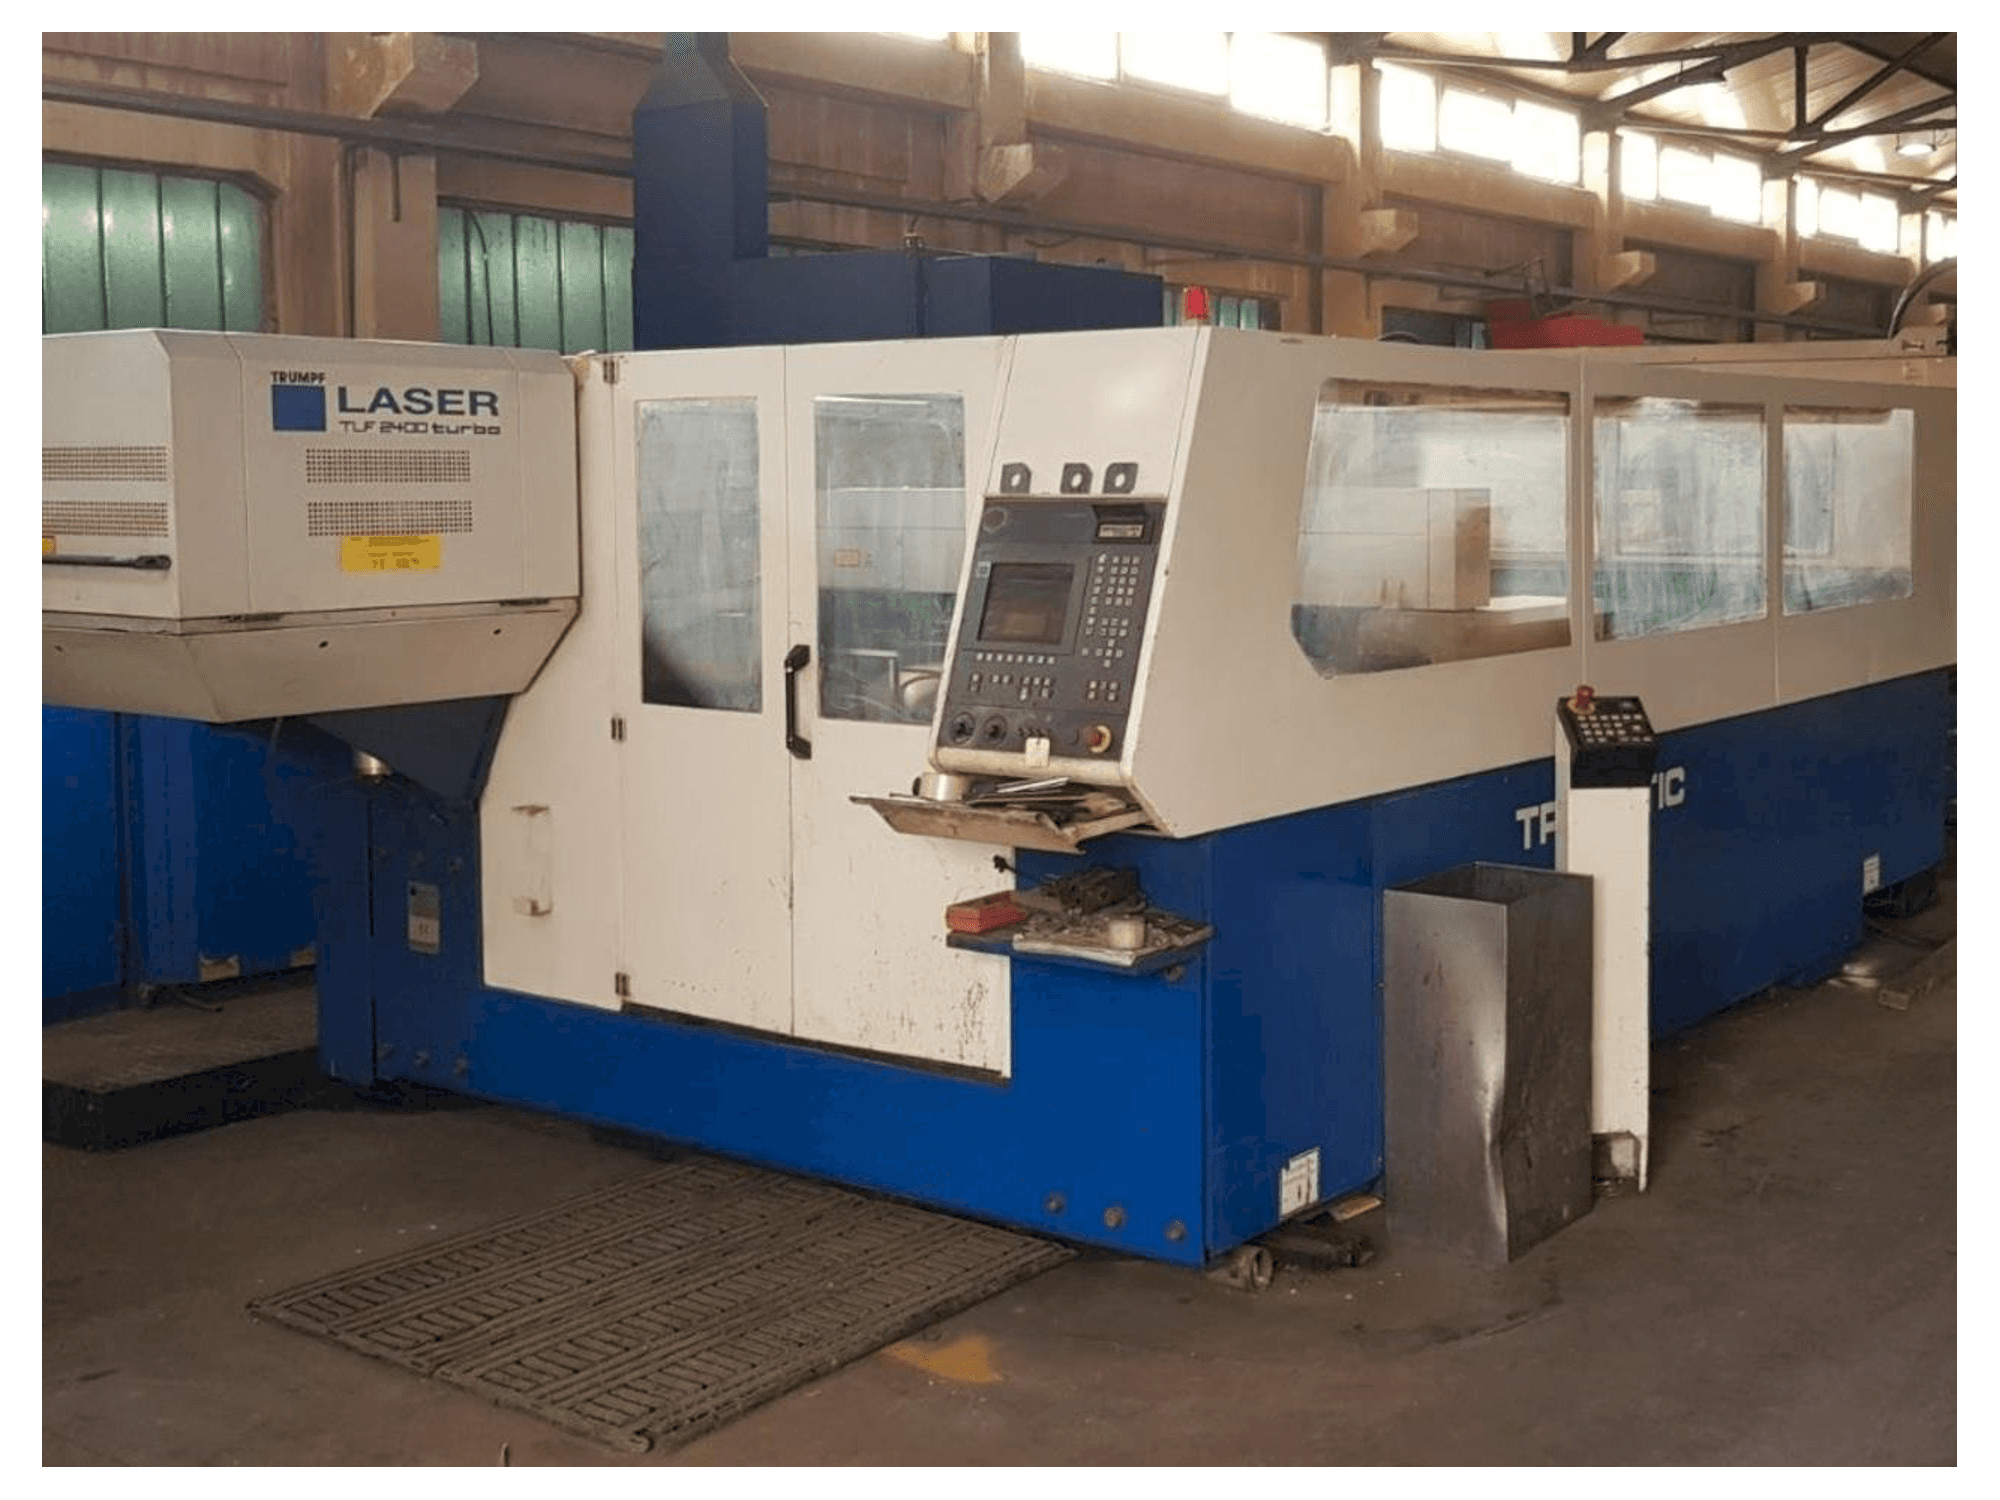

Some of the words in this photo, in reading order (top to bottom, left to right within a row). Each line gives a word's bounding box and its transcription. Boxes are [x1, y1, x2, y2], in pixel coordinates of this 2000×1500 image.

[270, 371, 326, 384] TRUMPF
[337, 386, 499, 416] LASER
[339, 420, 376, 434] TLF
[379, 421, 429, 434] 2400
[432, 422, 502, 436] turbo
